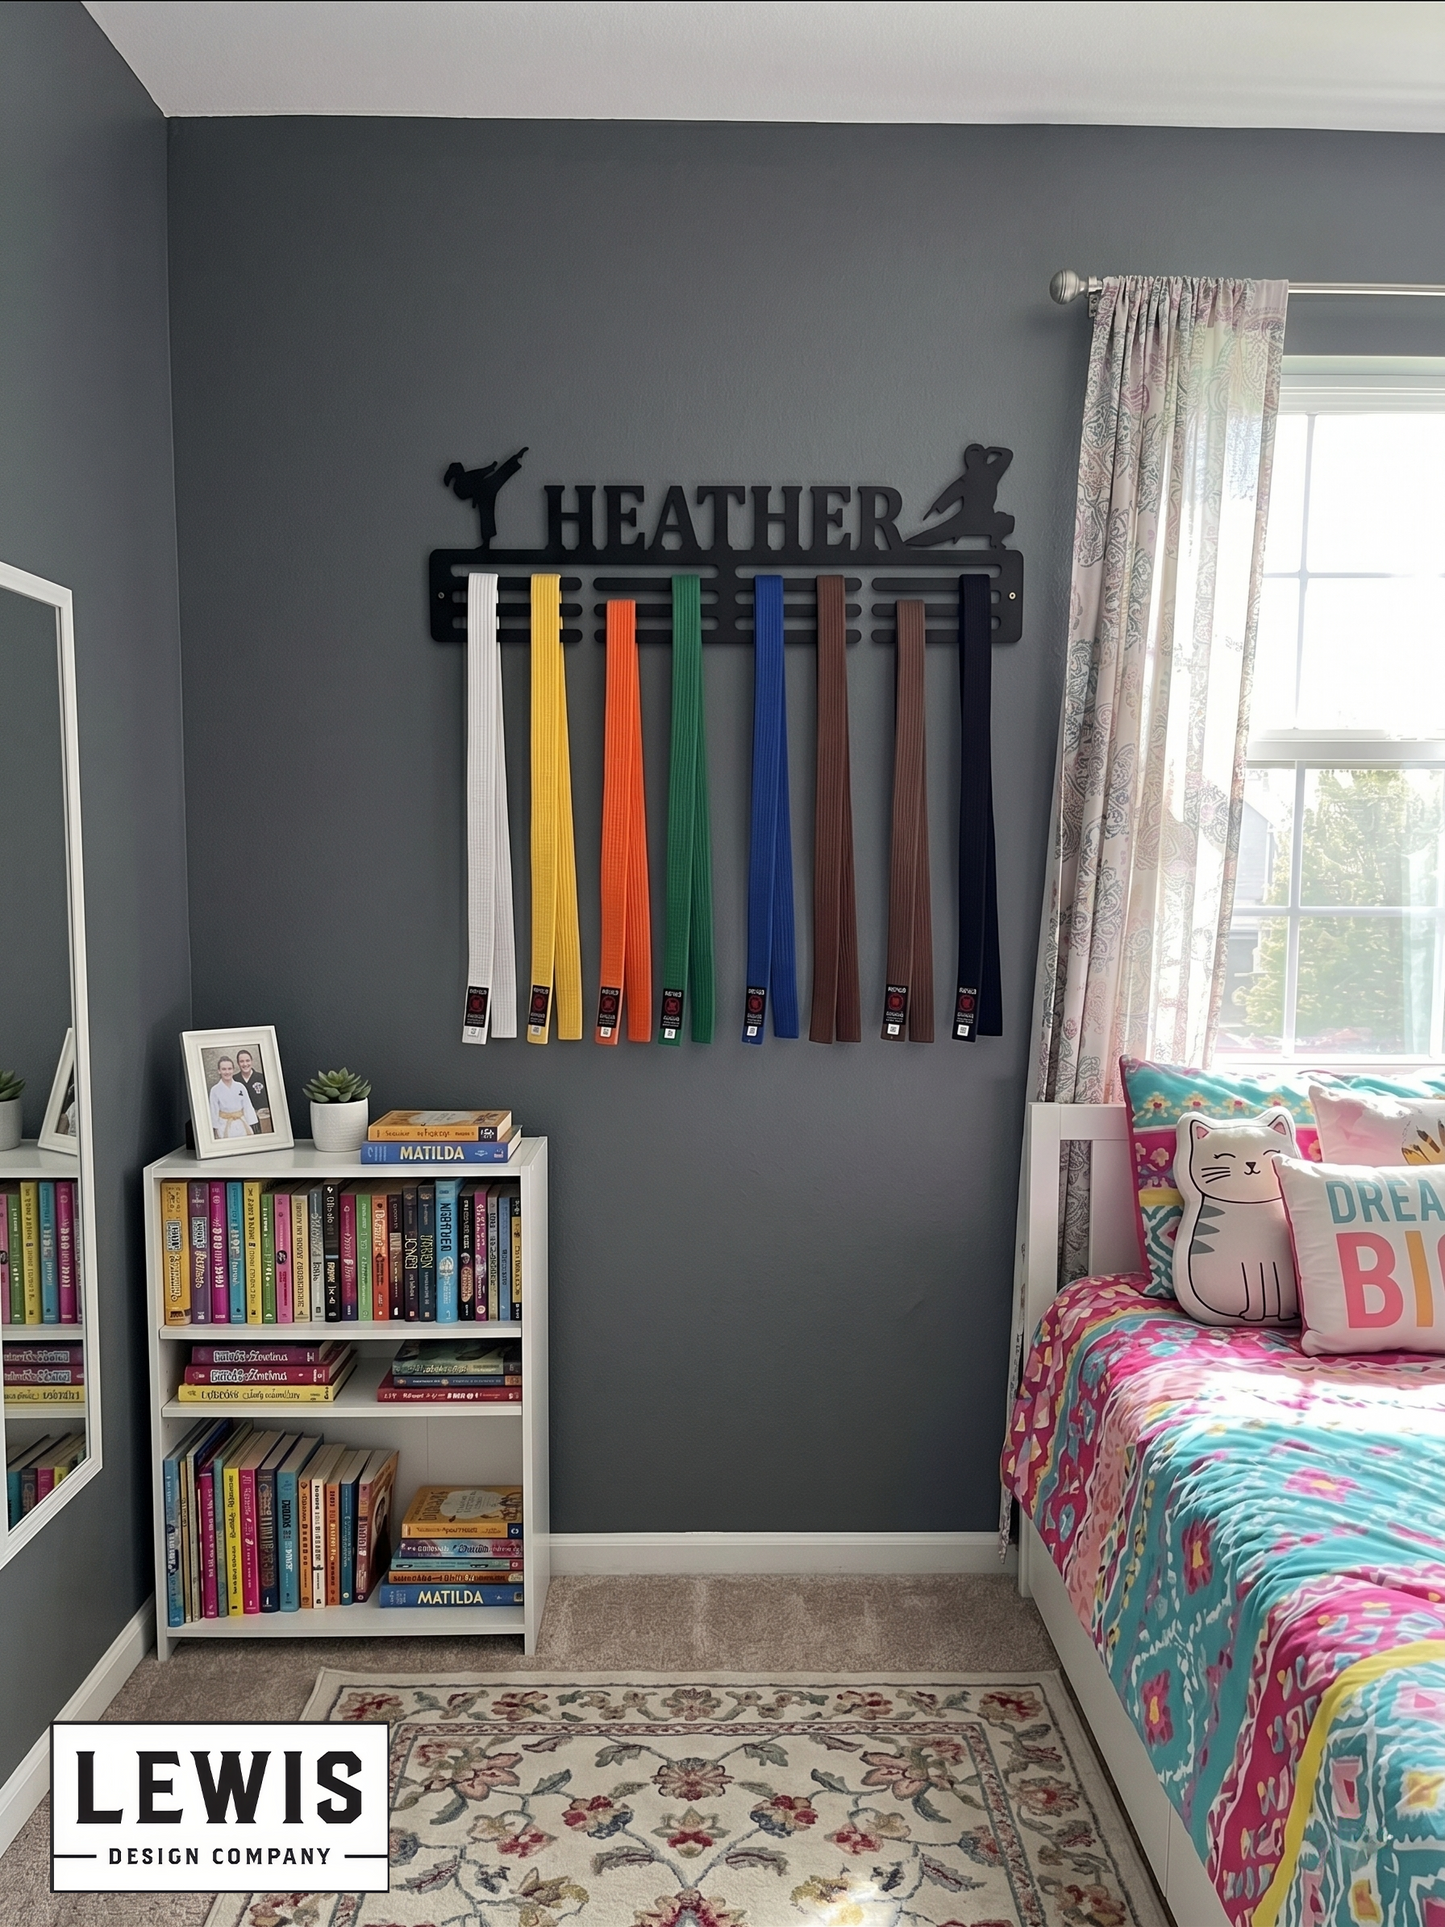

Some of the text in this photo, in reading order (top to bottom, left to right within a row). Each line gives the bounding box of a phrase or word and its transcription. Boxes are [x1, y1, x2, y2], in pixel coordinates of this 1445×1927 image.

[543, 485, 903, 551] HEATHER
[400, 1145, 465, 1160] MATILDA
[1336, 1230, 1445, 1329] BI
[417, 1590, 484, 1605] MATILDA
